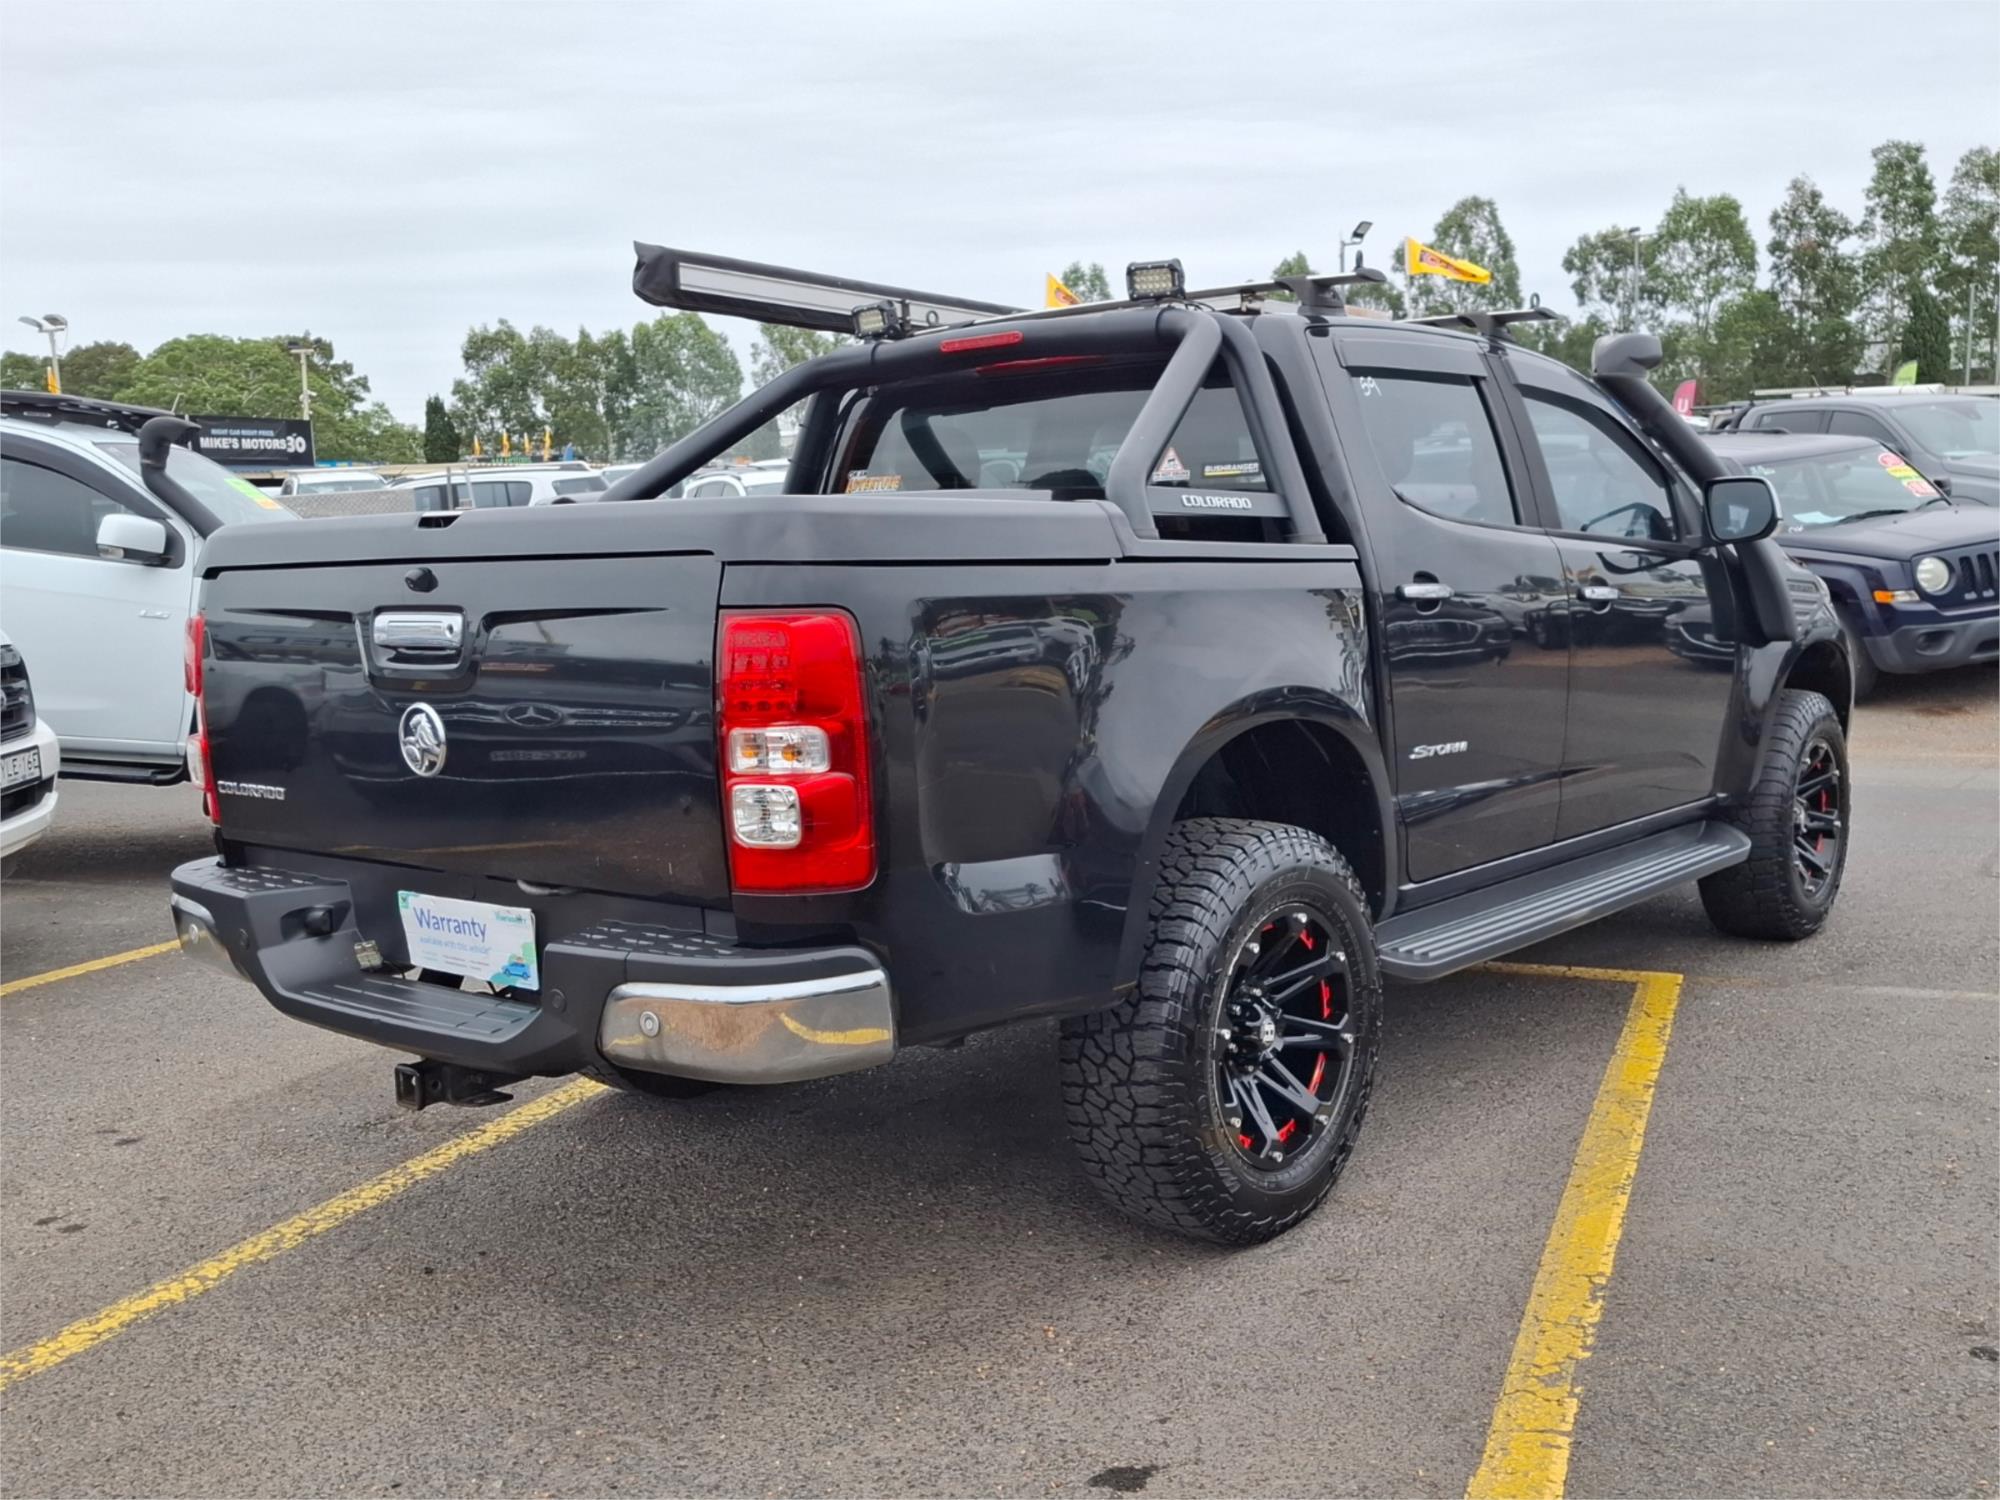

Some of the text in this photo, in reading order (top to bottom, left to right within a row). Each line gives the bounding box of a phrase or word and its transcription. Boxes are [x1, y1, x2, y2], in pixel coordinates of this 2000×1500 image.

[200, 437, 240, 449] MIKE'S
[242, 438, 287, 450] MOTORS
[1181, 494, 1252, 509] COLORADO
[217, 780, 286, 800] COLORADO
[413, 906, 487, 943] Warranty
